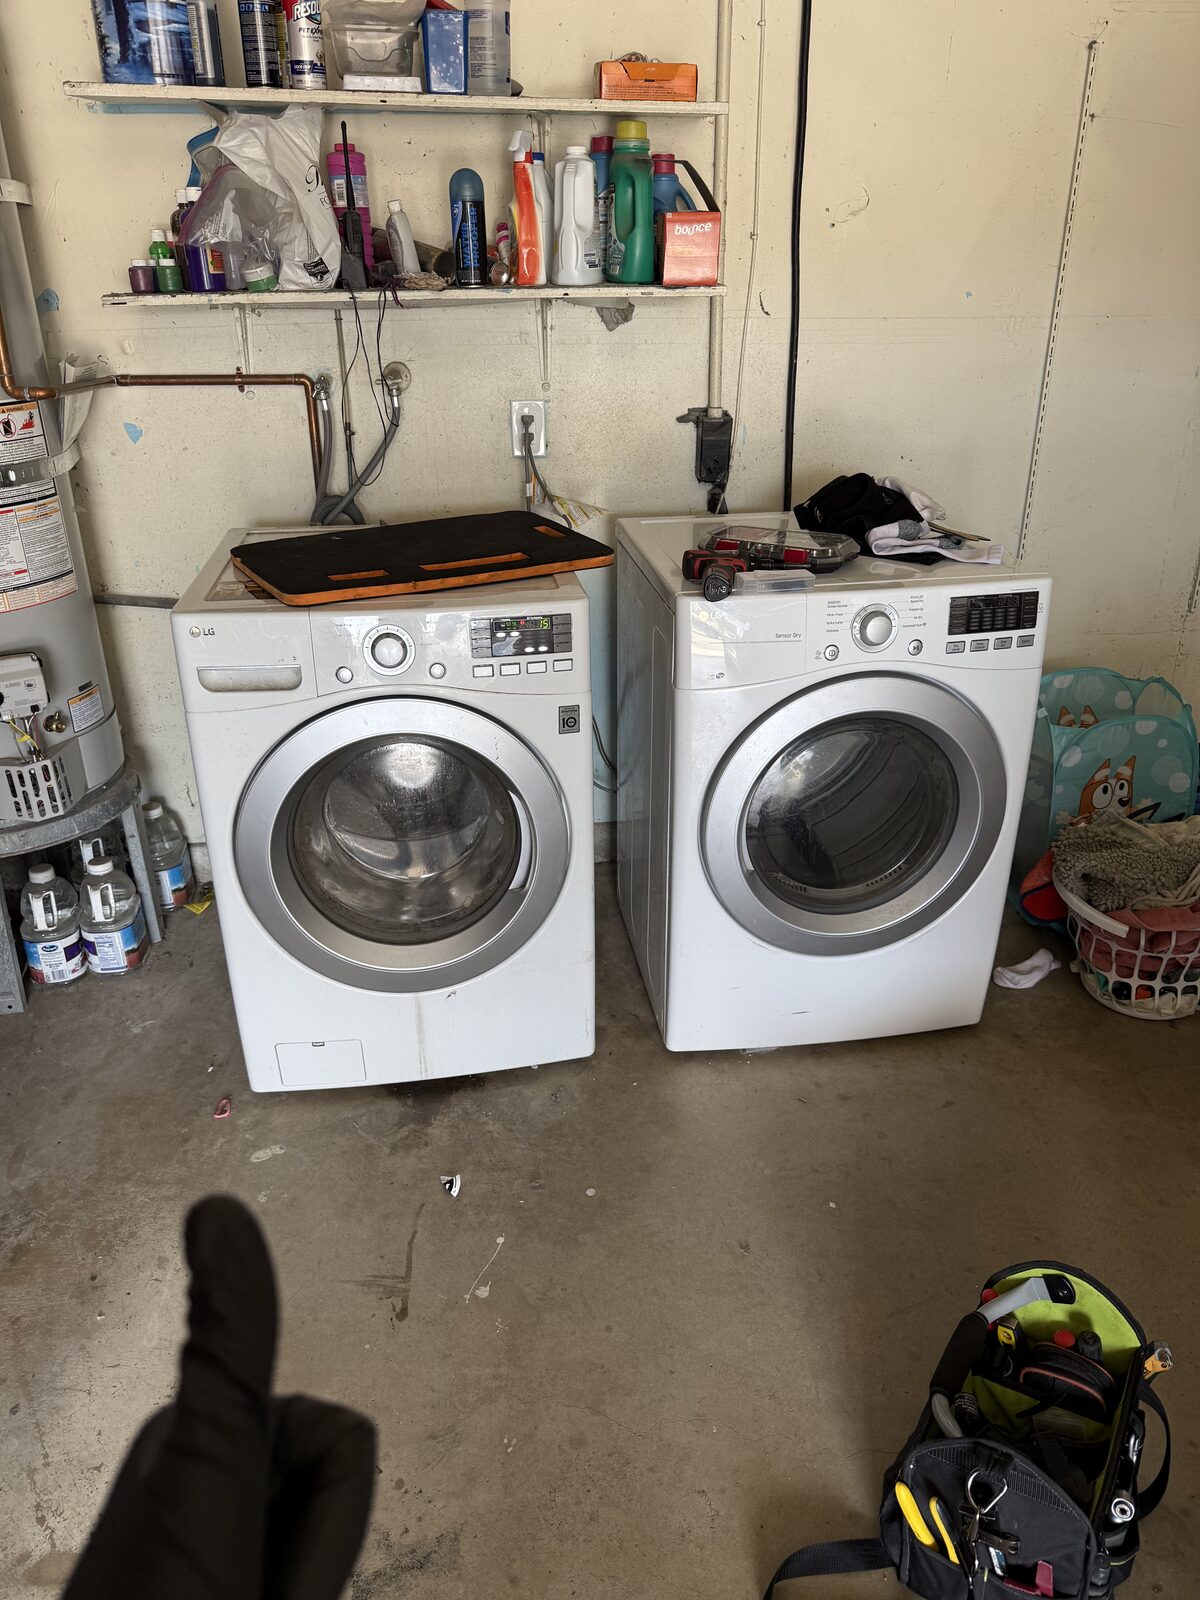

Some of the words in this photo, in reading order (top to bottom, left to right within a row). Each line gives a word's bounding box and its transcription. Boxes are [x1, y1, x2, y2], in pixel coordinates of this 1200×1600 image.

[675, 222, 712, 235] bounce
[469, 207, 480, 268] PROOFER
[461, 222, 471, 267] WATER
[203, 627, 216, 636] LG
[792, 632, 802, 640] Dry
